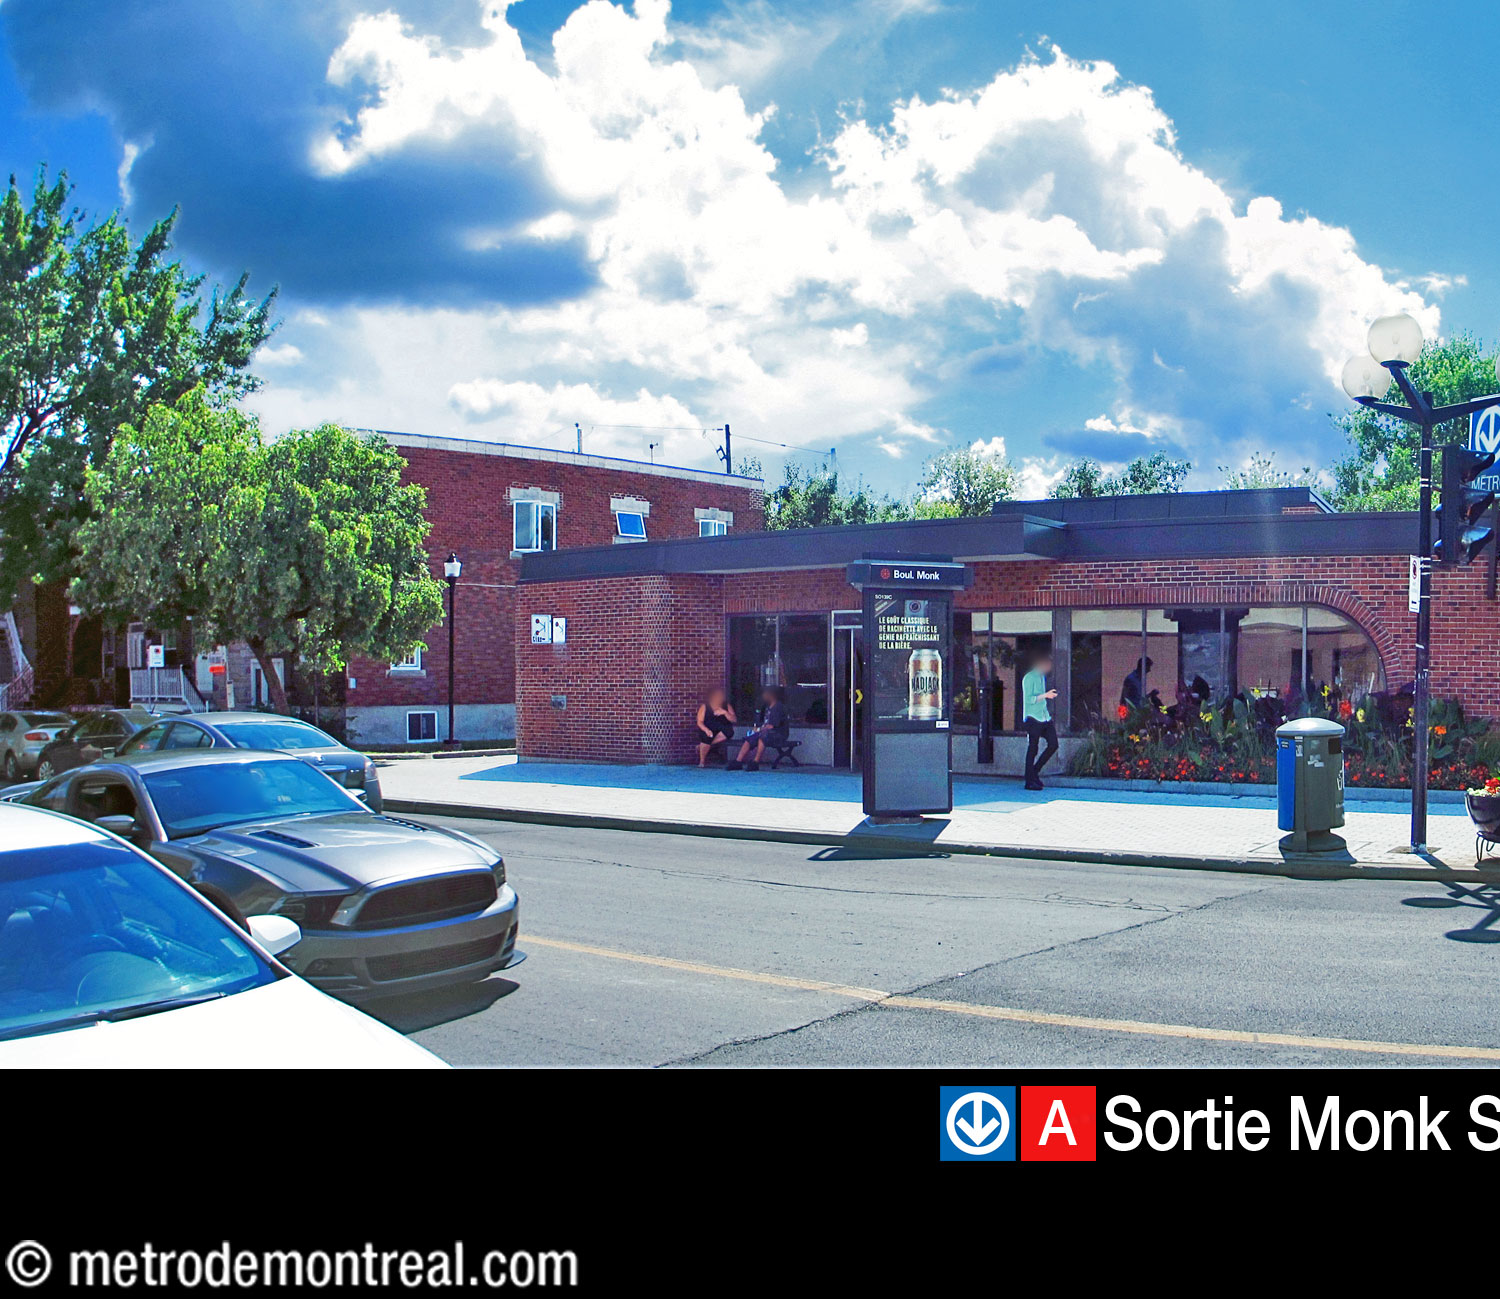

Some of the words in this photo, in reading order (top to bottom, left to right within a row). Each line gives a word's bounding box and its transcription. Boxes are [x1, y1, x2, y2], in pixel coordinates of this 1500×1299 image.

[893, 569, 915, 579] Boul.
[916, 570, 940, 581] Monk
[878, 616, 886, 624] LE
[900, 616, 930, 625] CLASSIQUE
[878, 625, 886, 633] DE
[931, 625, 938, 633] LE
[878, 641, 886, 649] DE
[887, 641, 895, 649] LA
